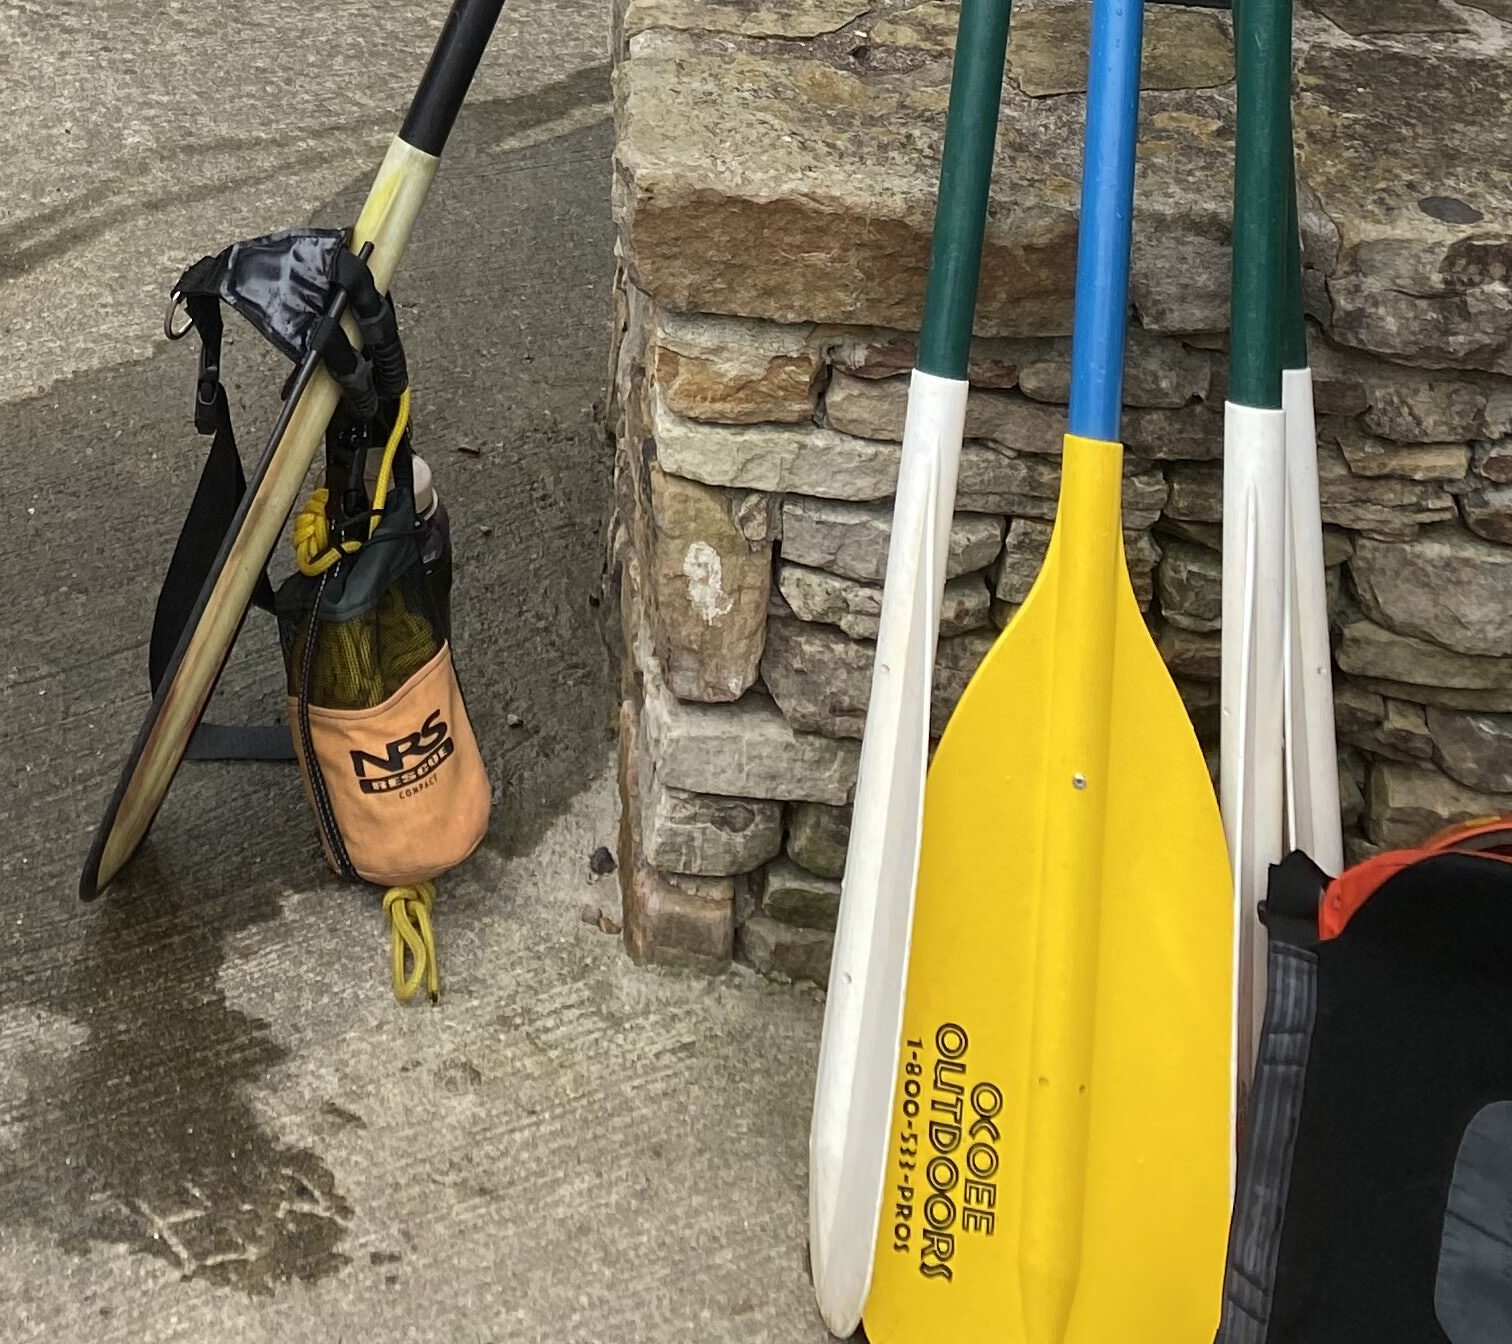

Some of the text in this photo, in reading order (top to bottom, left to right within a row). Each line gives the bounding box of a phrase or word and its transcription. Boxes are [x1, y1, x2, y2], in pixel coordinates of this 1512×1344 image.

[350, 709, 447, 777] NRS
[371, 747, 447, 791] RESCUE
[399, 774, 437, 800] COMPACT
[894, 1037, 923, 1253] 1-800-533-PROS
[920, 1022, 969, 1283] OUTDOORS
[962, 1081, 1004, 1236] OCOEE
